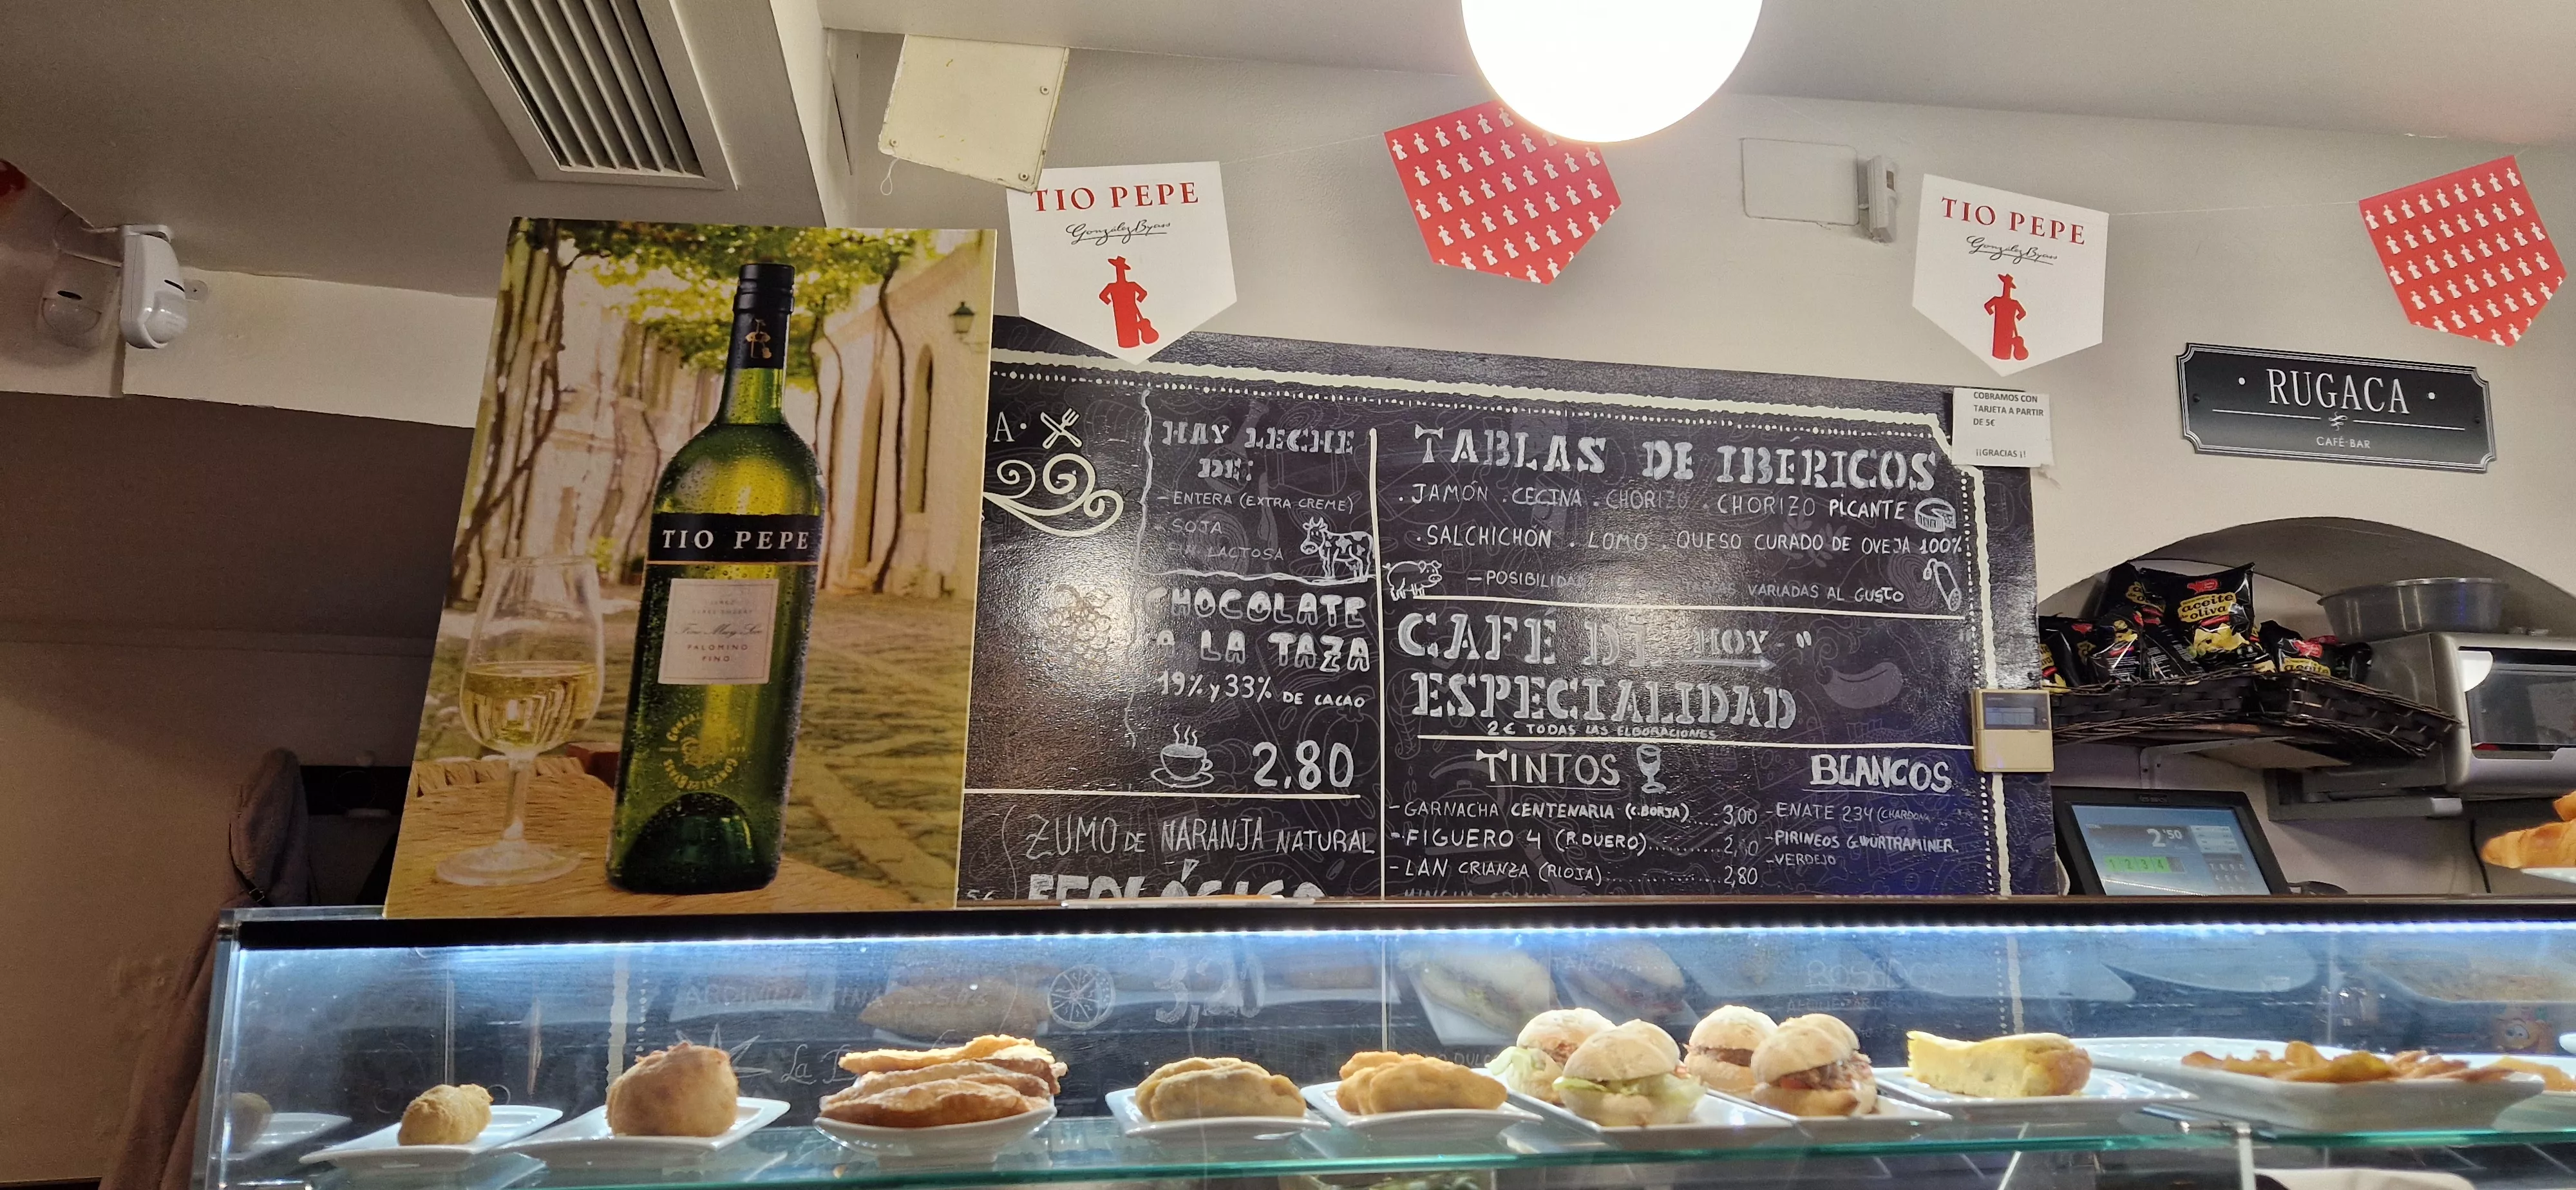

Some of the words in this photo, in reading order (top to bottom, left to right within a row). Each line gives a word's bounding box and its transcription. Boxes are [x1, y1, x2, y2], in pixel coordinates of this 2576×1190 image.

[1031, 187, 1095, 212] TIO
[1109, 182, 1199, 209] PEPE
[1941, 196, 1996, 225] TIO
[2009, 211, 2085, 245] PEPE
[1973, 392, 2019, 402] COBRAMOS
[2021, 395, 2038, 403] CON
[2266, 368, 2410, 414] RUGACA
[1974, 405, 2007, 414] TARJETA
[2016, 408, 2044, 417] PARTIR
[1162, 420, 1229, 446] HAY
[1245, 428, 1354, 454] LECHE
[1414, 424, 1607, 473] TABLAS
[1642, 440, 1694, 481] DE
[1197, 458, 1255, 482] DE:
[1173, 491, 1233, 505] ENTERA
[1240, 492, 1291, 509] (EXTRA
[1298, 496, 1354, 515] CREME)
[1411, 480, 1488, 504] JAMÓN
[1511, 486, 1582, 507] CECINA
[1606, 489, 1687, 509] CHORIZO
[1717, 493, 1815, 517] CHORIZO
[1829, 493, 1907, 520] PICANTE
[662, 529, 714, 549] TIO
[734, 531, 809, 550] PEPE
[1172, 518, 1222, 534] SOJA
[1426, 522, 1551, 548] SALCHICHÓN
[1588, 532, 1647, 551] LOMO
[1676, 530, 1742, 550] QUESO
[1754, 533, 1823, 552] CURADO
[1832, 536, 1852, 551] DE
[1861, 537, 1910, 555] OVEJA
[1919, 536, 1962, 555] 100%
[1208, 546, 1283, 560] LACTOSA
[1144, 587, 1366, 628] CHOCOLATE
[1748, 584, 1819, 599] VARIADAS
[1828, 589, 1844, 601] AL
[1855, 588, 1904, 603] GUSTO
[2182, 594, 2233, 613] aceite
[2190, 604, 2227, 620] oliva
[1156, 629, 1175, 658] A
[1200, 629, 1246, 664] LA
[1267, 632, 1370, 672] TAZA
[1581, 619, 1663, 668] DE
[1693, 627, 1768, 655] HOY
[1224, 674, 1273, 700] 33%
[1282, 691, 1303, 706] DE
[1314, 694, 1365, 708] CACAO
[1410, 672, 1797, 729] ESPECIALIDAD
[1526, 724, 1576, 736] TODAS
[1585, 724, 1609, 736] LAS
[1252, 739, 1354, 791] 2,80
[1475, 748, 1621, 786] TINTOS
[1810, 753, 1952, 793] BLANCOS
[1405, 801, 1499, 817] GARNACHA
[1511, 802, 1615, 820] CENTENARIA
[1723, 804, 1757, 826] 3,00
[1776, 802, 1835, 820] ENATE
[1842, 806, 1872, 823] 234
[1026, 813, 1119, 860] ZUMO
[1124, 832, 1146, 853] DE
[1161, 816, 1264, 851] NARANJA
[1276, 828, 1376, 855] NATURAL
[1406, 827, 1514, 849] FIGUERO
[1526, 829, 1541, 850] 4
[1774, 829, 1840, 849] PIRINEOS
[1405, 858, 1448, 877] LAN
[1458, 861, 1530, 878] CRIANZA
[1539, 861, 1603, 886] (RIOJA)
[1723, 865, 1758, 887] 2,80
[1774, 853, 1837, 867] VERDEJO
